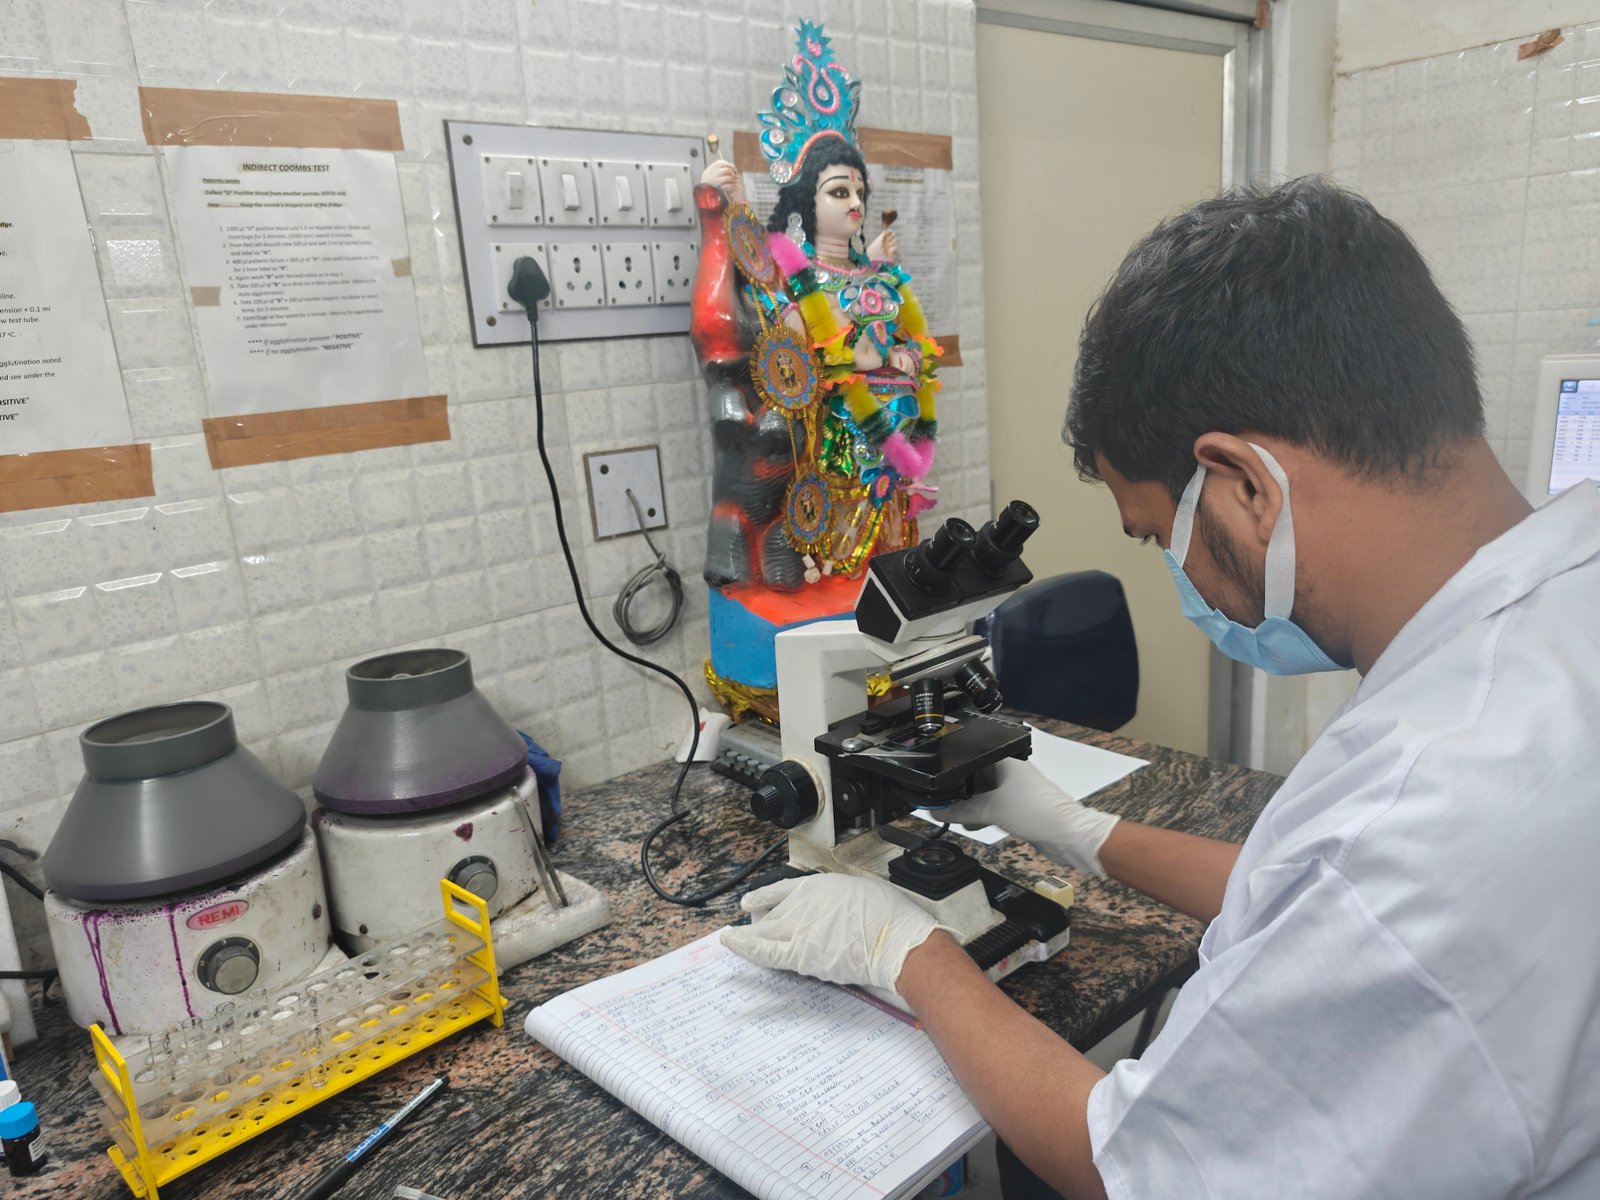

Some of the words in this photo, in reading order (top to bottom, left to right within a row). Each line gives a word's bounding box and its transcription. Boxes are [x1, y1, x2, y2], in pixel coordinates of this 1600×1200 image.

[242, 164, 277, 172] INDIRECT
[279, 164, 311, 172] COOMBS
[313, 164, 330, 172] TEST
[198, 905, 240, 926] REMI
